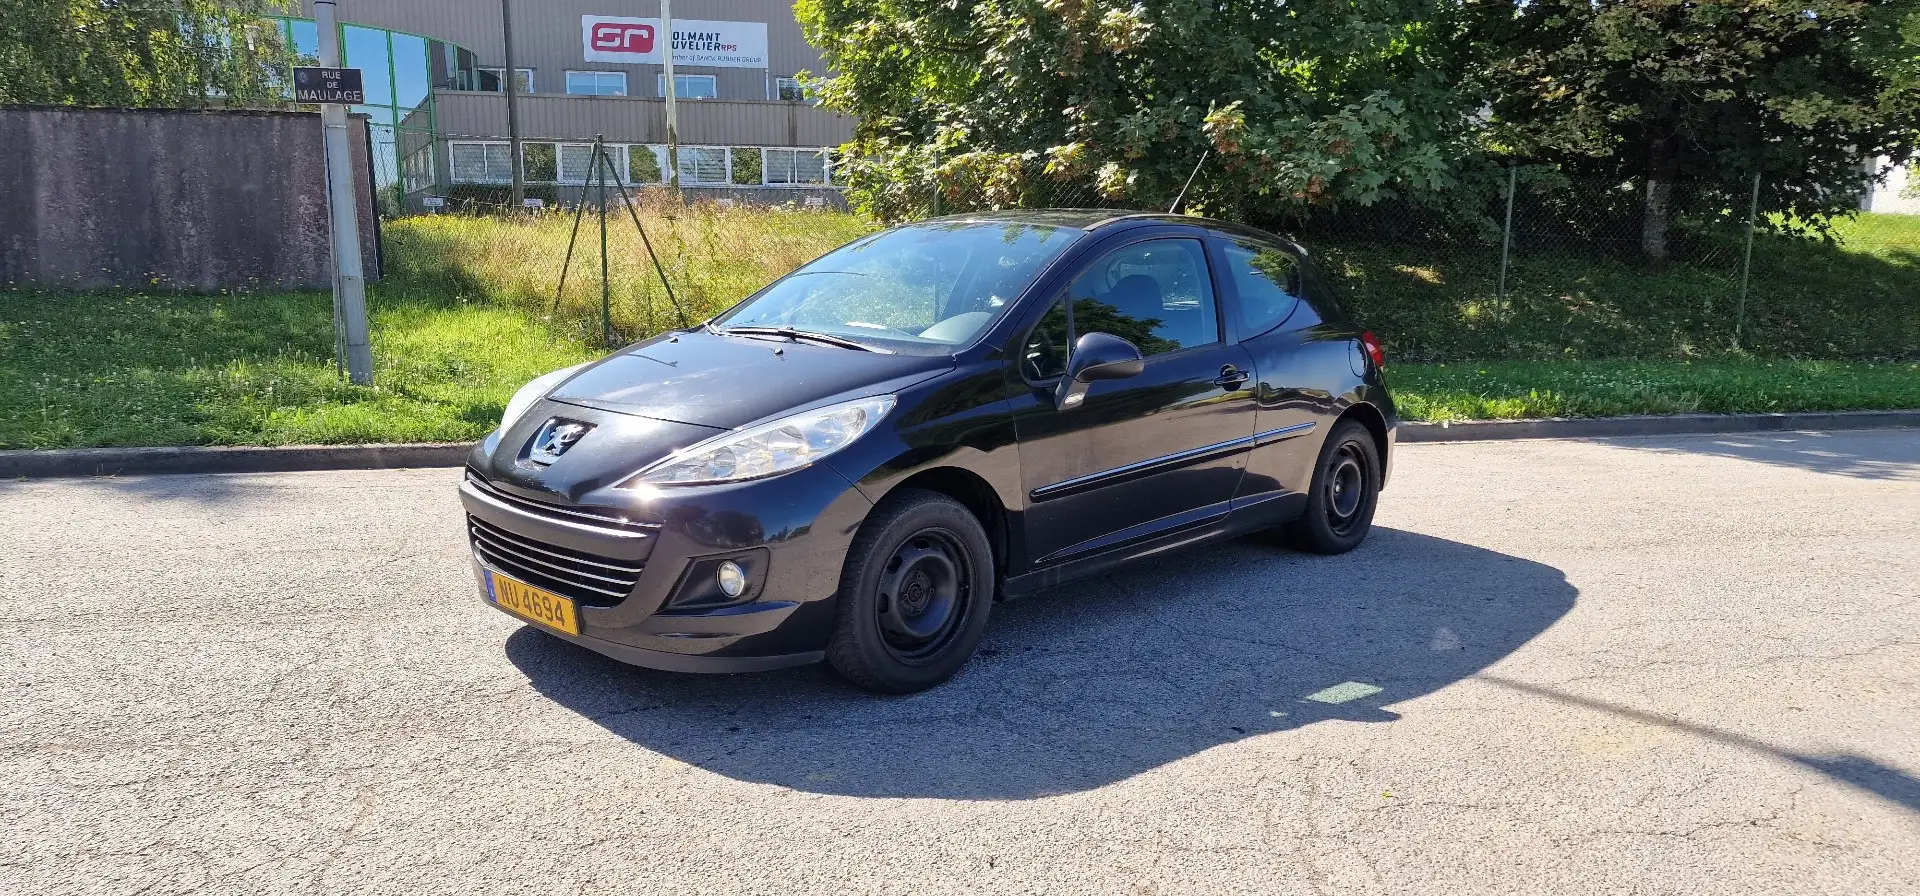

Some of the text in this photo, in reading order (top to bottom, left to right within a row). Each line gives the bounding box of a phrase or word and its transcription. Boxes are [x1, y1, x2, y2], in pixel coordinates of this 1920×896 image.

[672, 31, 721, 42] OLMANT
[672, 40, 738, 52] UVELIER RPS
[321, 71, 341, 80] RUE
[326, 81, 339, 89] DE
[297, 89, 362, 102] MAULAGE
[499, 578, 566, 627] NU 4694
